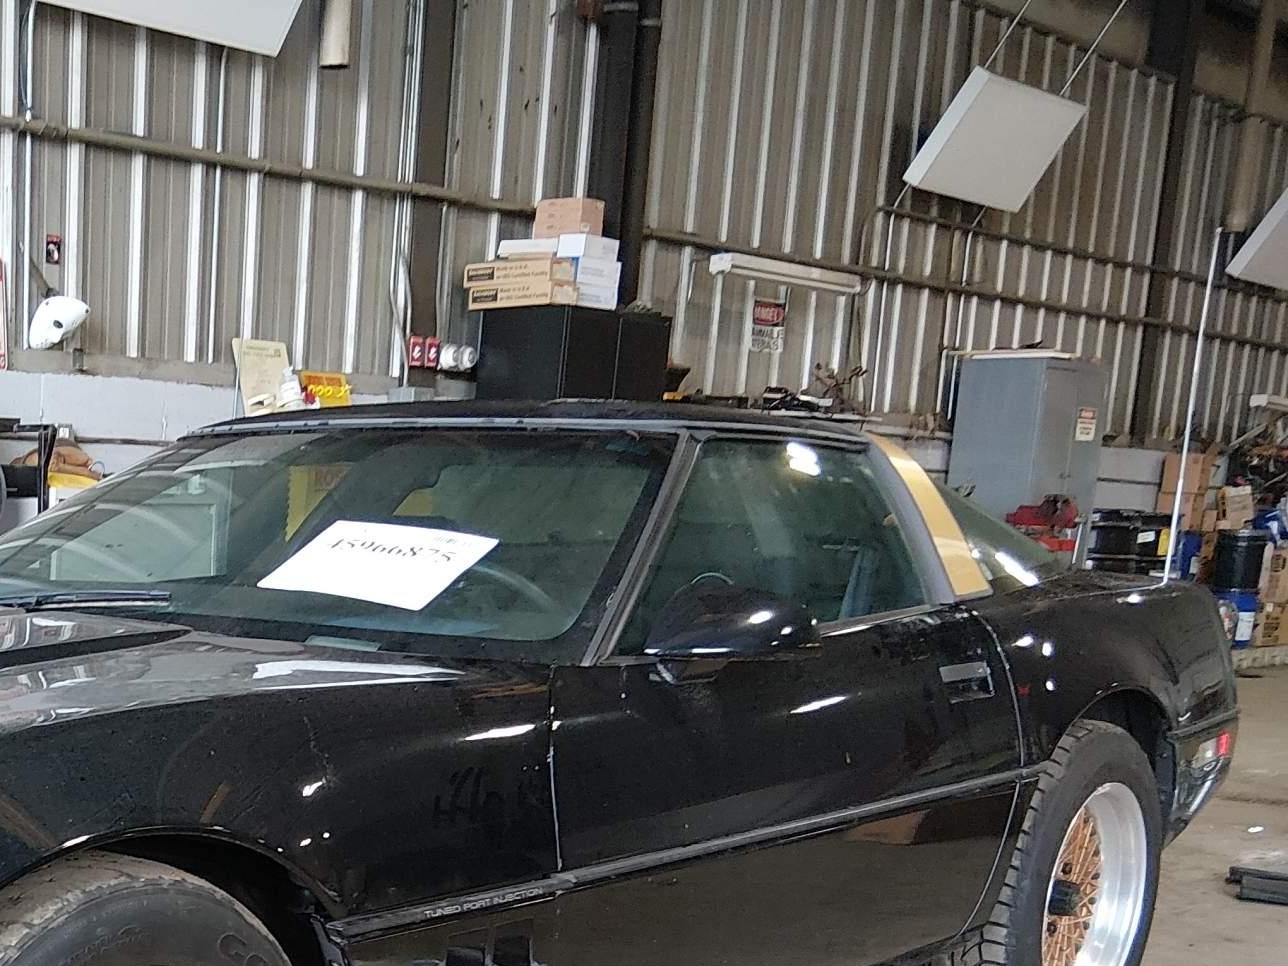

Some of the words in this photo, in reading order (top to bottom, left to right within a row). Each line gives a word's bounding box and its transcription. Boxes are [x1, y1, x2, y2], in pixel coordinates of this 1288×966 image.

[423, 905, 462, 919] TUNED
[463, 898, 491, 912] PORT
[493, 887, 543, 905] INJECTION
